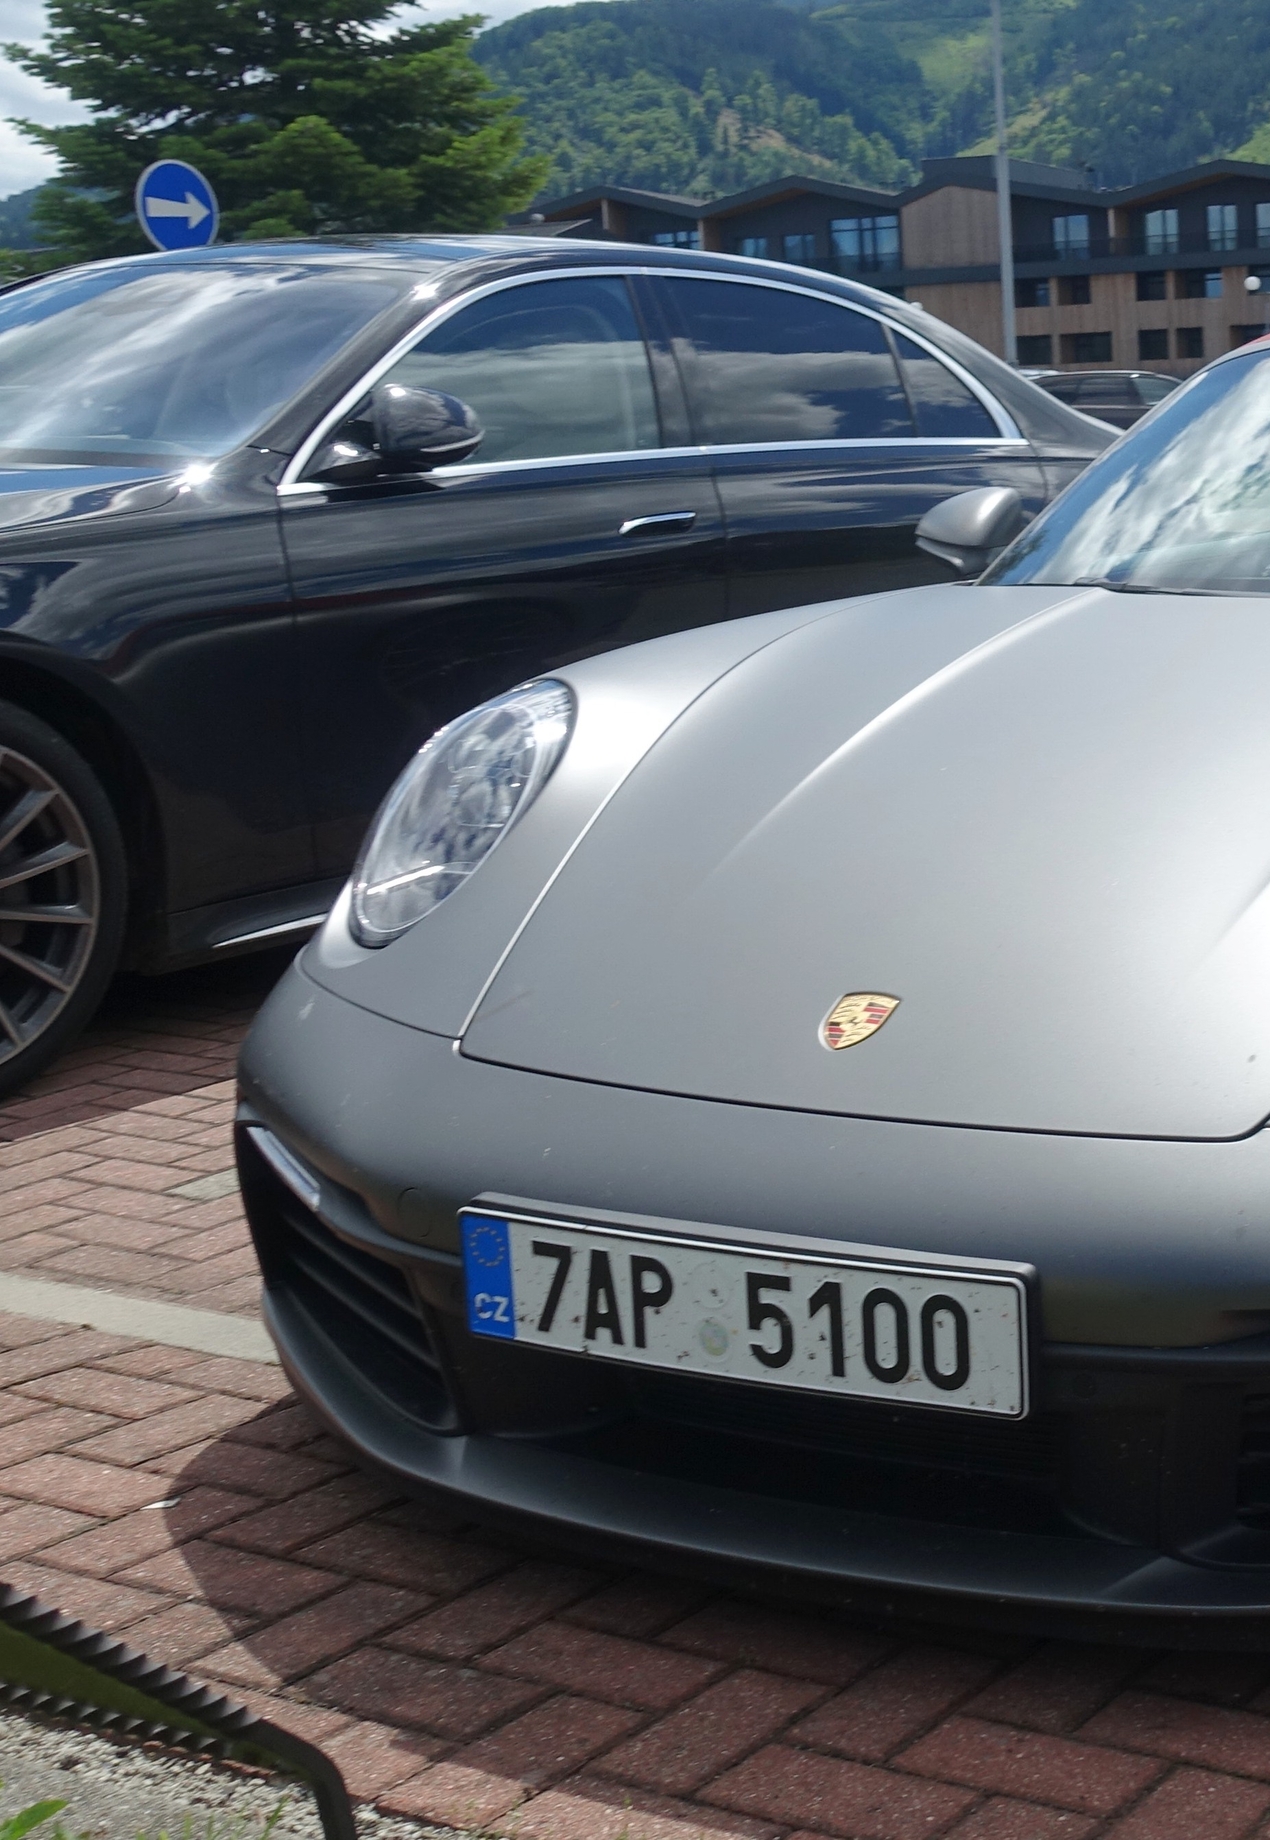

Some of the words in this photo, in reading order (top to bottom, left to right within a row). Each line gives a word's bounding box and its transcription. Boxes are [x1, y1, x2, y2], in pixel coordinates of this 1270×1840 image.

[474, 1292, 510, 1323] CZ
[531, 1240, 674, 1349] 7AP
[744, 1271, 971, 1392] 5100
